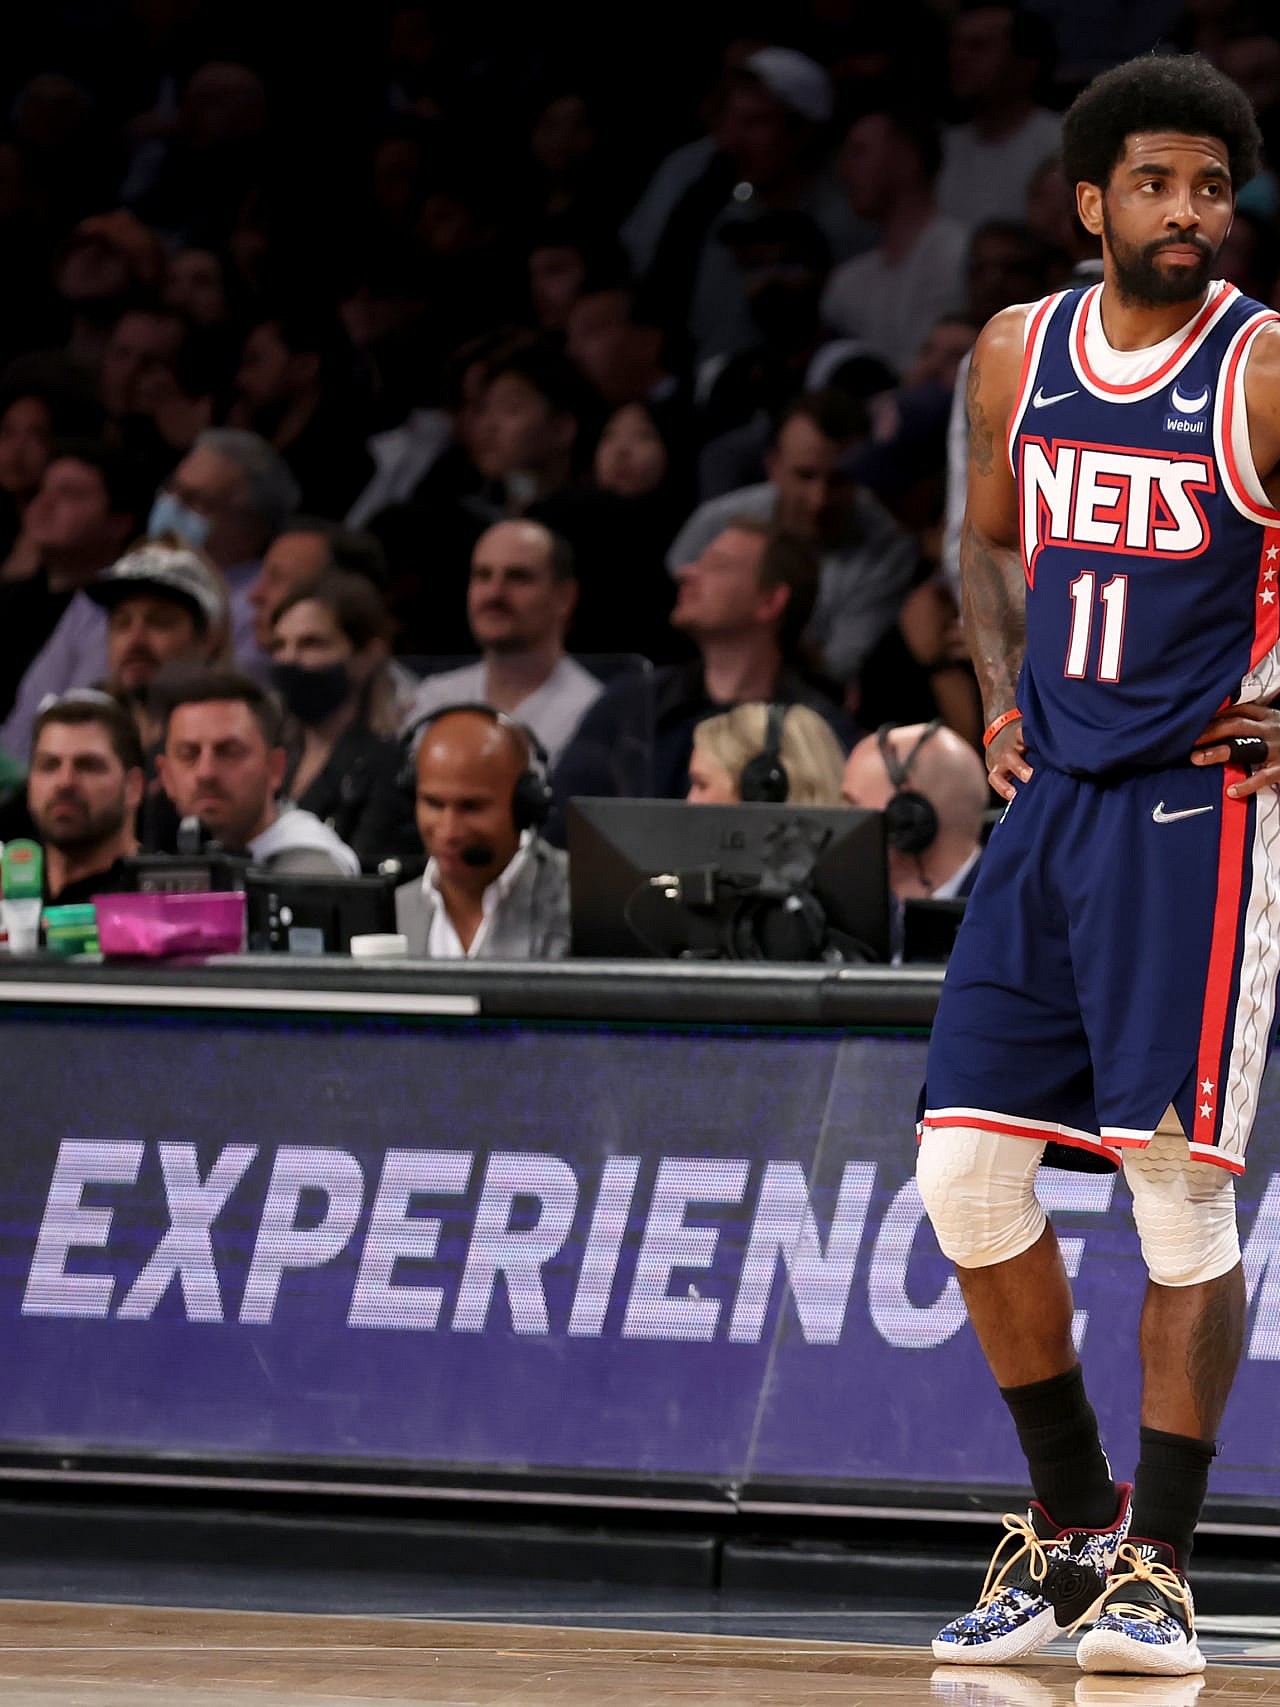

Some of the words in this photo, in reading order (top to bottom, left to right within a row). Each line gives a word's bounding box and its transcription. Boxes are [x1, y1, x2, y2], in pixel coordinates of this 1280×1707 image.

[1167, 418, 1204, 433] Webull
[1019, 435, 1216, 590] NETS
[1064, 571, 1128, 683] 11
